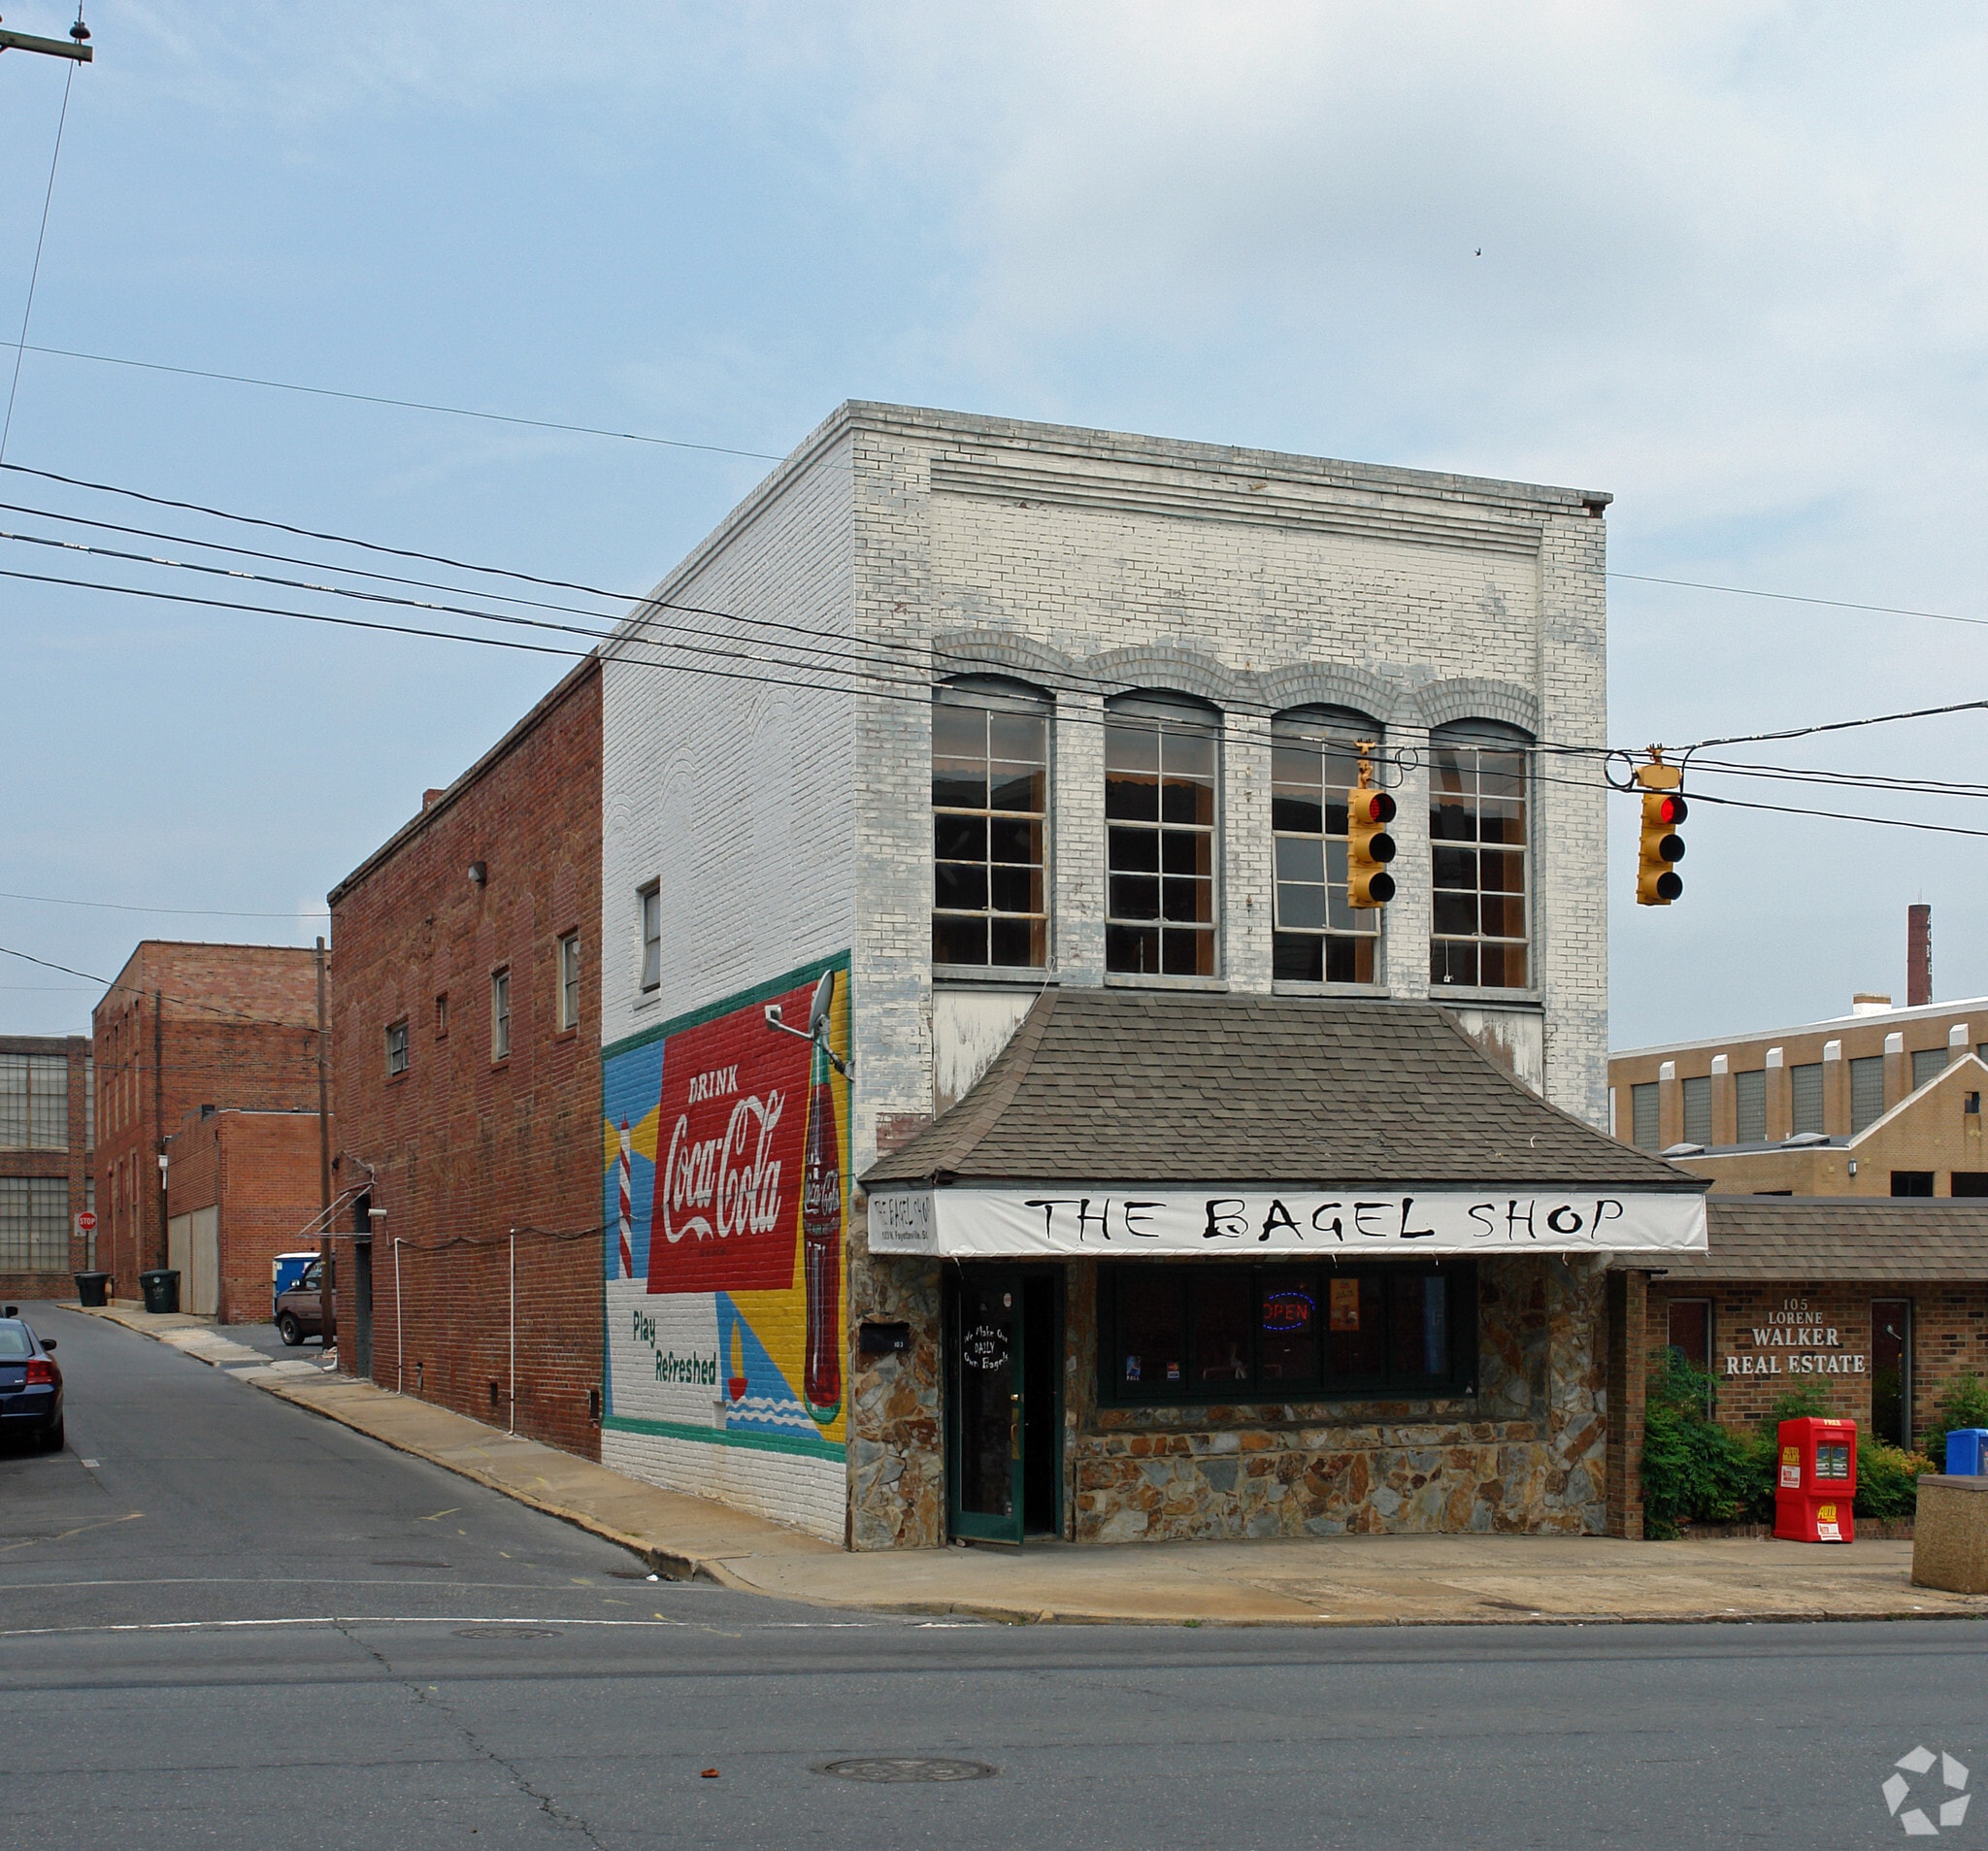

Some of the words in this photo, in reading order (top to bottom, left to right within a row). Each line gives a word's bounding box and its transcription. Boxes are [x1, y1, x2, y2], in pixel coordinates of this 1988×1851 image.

[688, 1065, 739, 1104] DRINK
[1024, 1198, 1167, 1241] THE
[1203, 1198, 1436, 1241] BAGEL
[1468, 1198, 1624, 1240] SHOP
[1264, 1304, 1308, 1320] OPEN
[1783, 1299, 1808, 1310] 105
[1768, 1311, 1824, 1325] LORENE
[633, 1310, 656, 1349] Play
[1752, 1328, 1839, 1346] WALKER
[975, 1340, 995, 1354] DAILY
[655, 1349, 716, 1385] Refreshed
[1726, 1356, 1782, 1374] REAL
[1788, 1355, 1866, 1373] ESTATE
[1817, 1505, 1837, 1520] AUTO
